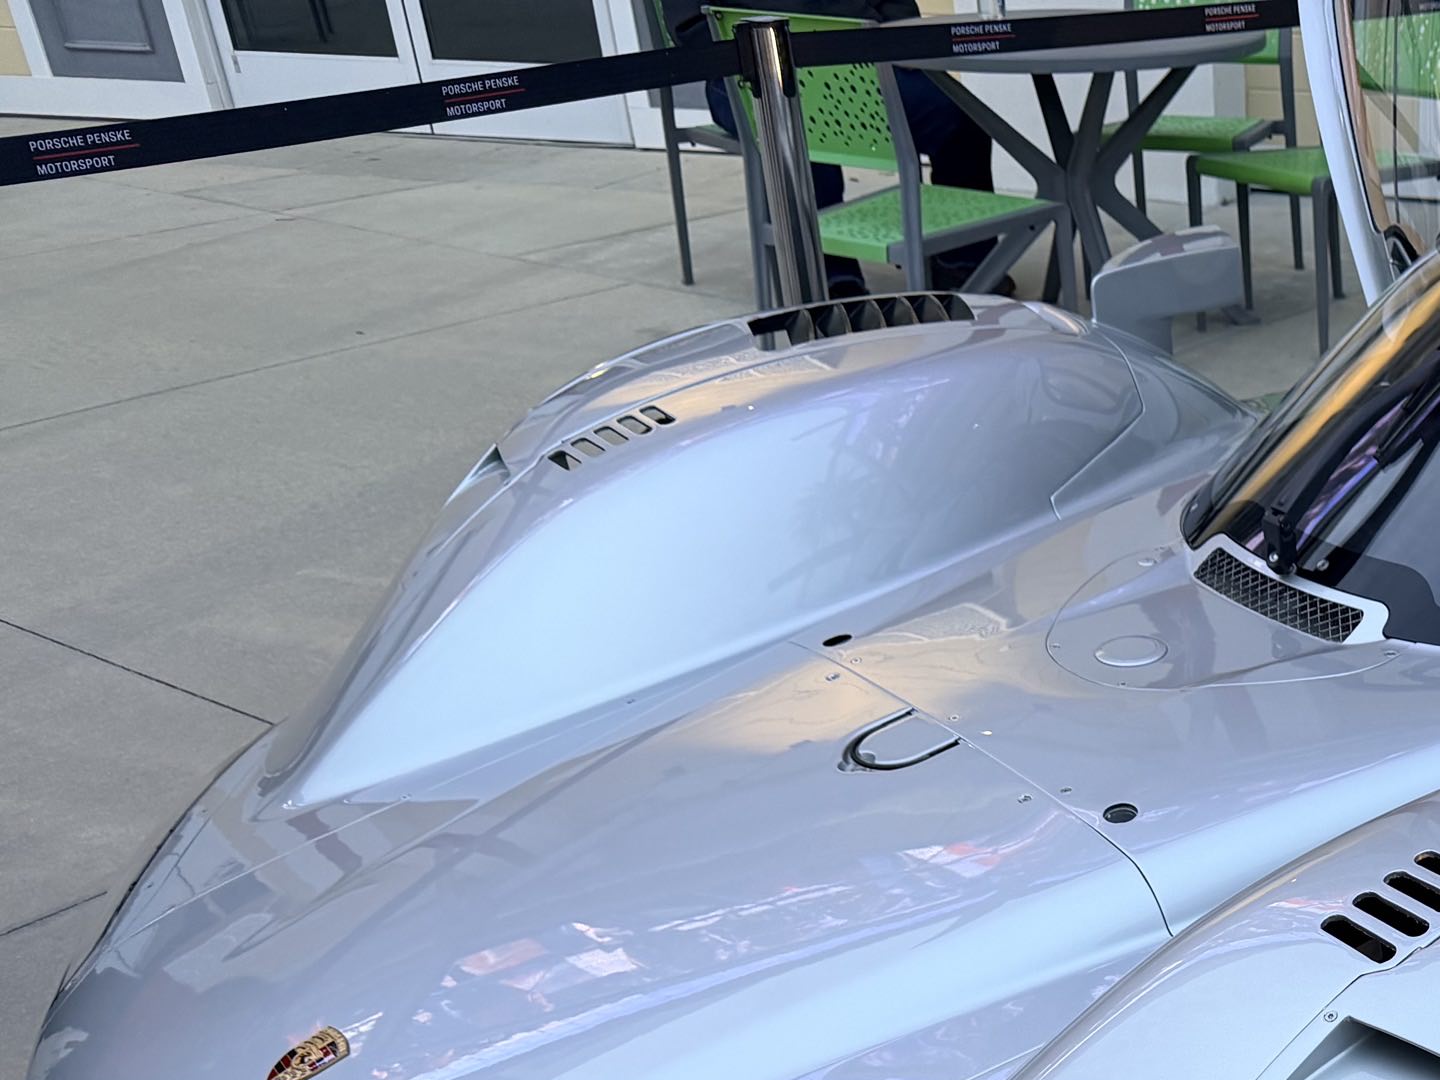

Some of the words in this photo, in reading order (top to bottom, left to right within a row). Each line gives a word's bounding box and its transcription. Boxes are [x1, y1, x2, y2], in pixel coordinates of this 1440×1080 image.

[951, 24, 983, 36] PORSCHE
[984, 23, 1012, 33] PENSKE
[952, 41, 1000, 53] MOTORSPORT
[441, 80, 484, 96] PORSCHE
[485, 75, 519, 90] PENSKE
[446, 98, 506, 117] MOTORSPORT
[28, 136, 85, 152] PORSCHE
[86, 129, 132, 145] PENSKE
[36, 155, 115, 176] MOTORSPORT
